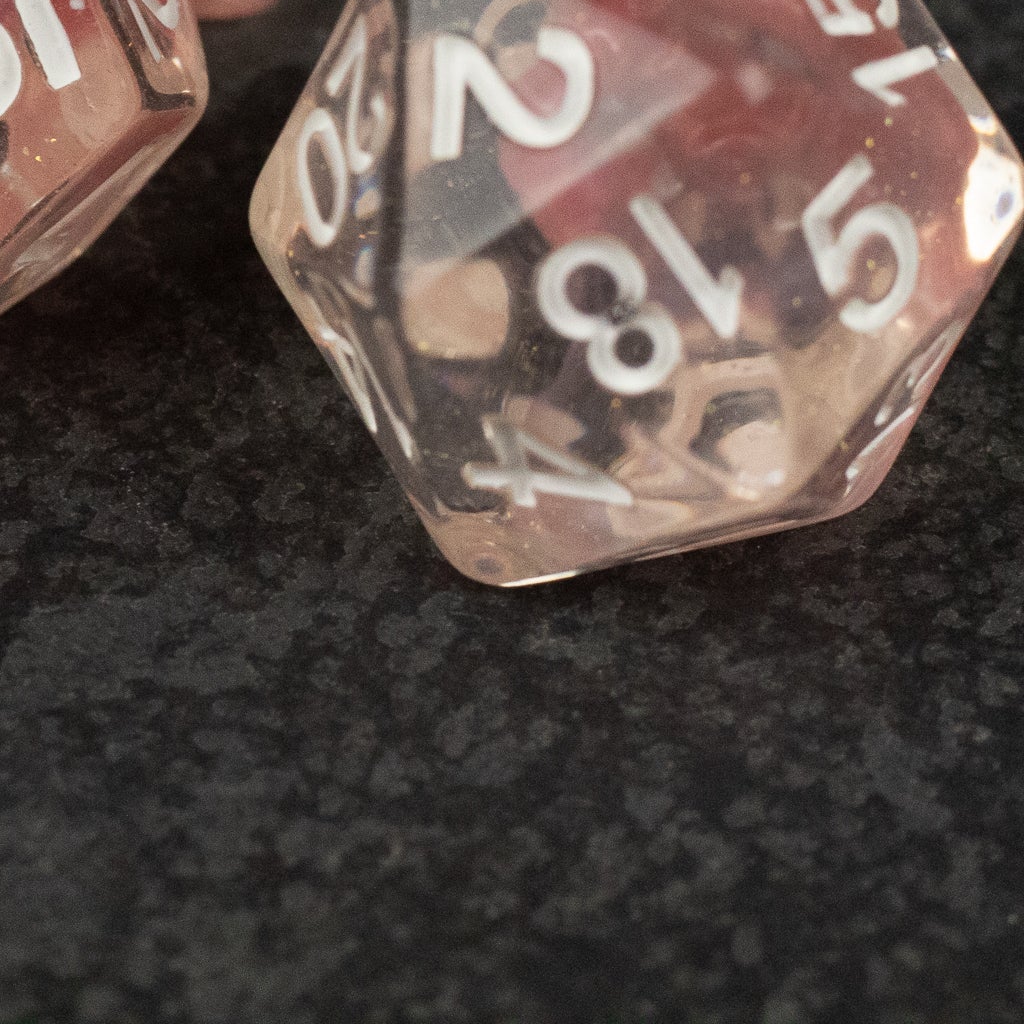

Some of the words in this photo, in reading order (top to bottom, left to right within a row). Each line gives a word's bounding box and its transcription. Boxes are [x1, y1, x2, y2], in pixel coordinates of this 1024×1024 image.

[296, 14, 387, 247] 20
[430, 29, 594, 160] 2
[536, 195, 744, 395] 18
[801, 157, 919, 333] 5
[462, 412, 632, 507] 4
